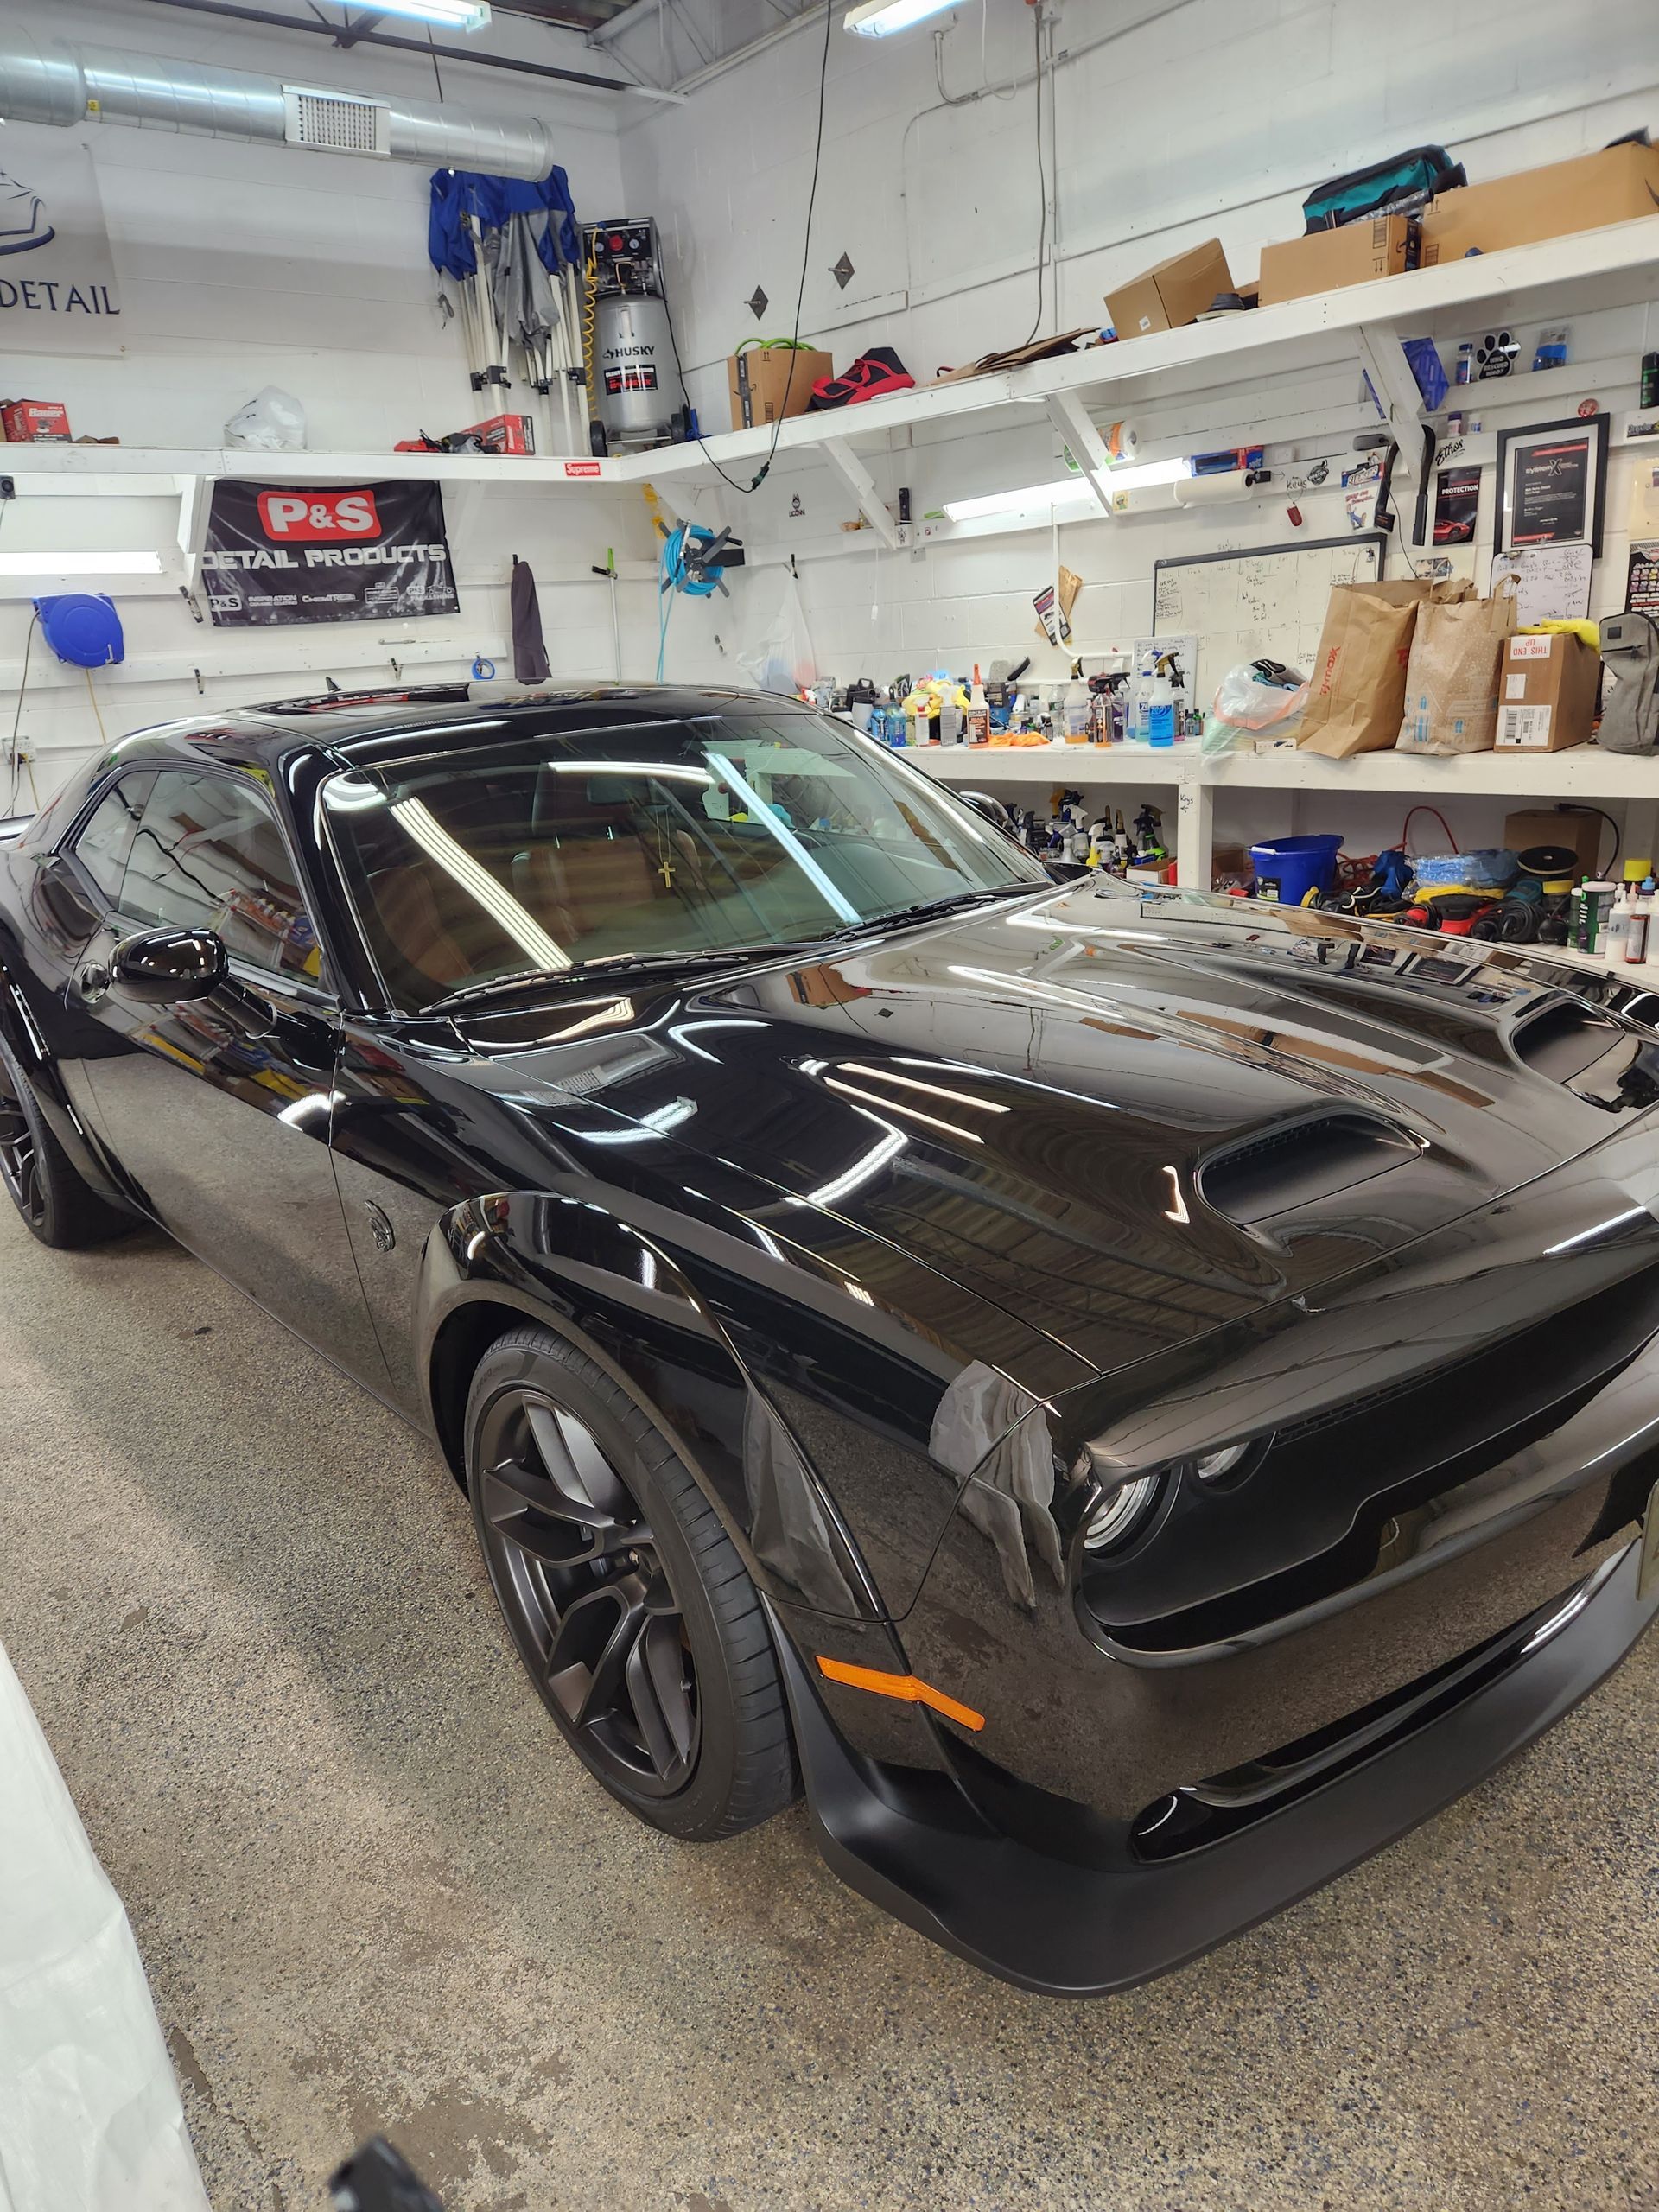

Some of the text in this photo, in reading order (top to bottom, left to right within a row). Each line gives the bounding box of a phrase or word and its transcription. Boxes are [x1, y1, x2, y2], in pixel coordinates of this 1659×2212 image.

[0, 279, 121, 315] DETAIL
[615, 346, 655, 357] HUSKY
[567, 464, 599, 475] Supreme
[1441, 485, 1478, 495] PROTECTION
[267, 497, 373, 532] P&S
[201, 544, 447, 569] DETAIL PRODUCTS
[210, 598, 239, 608] P&S
[1525, 639, 1535, 647] UP
[1513, 646, 1548, 656] THIS END
